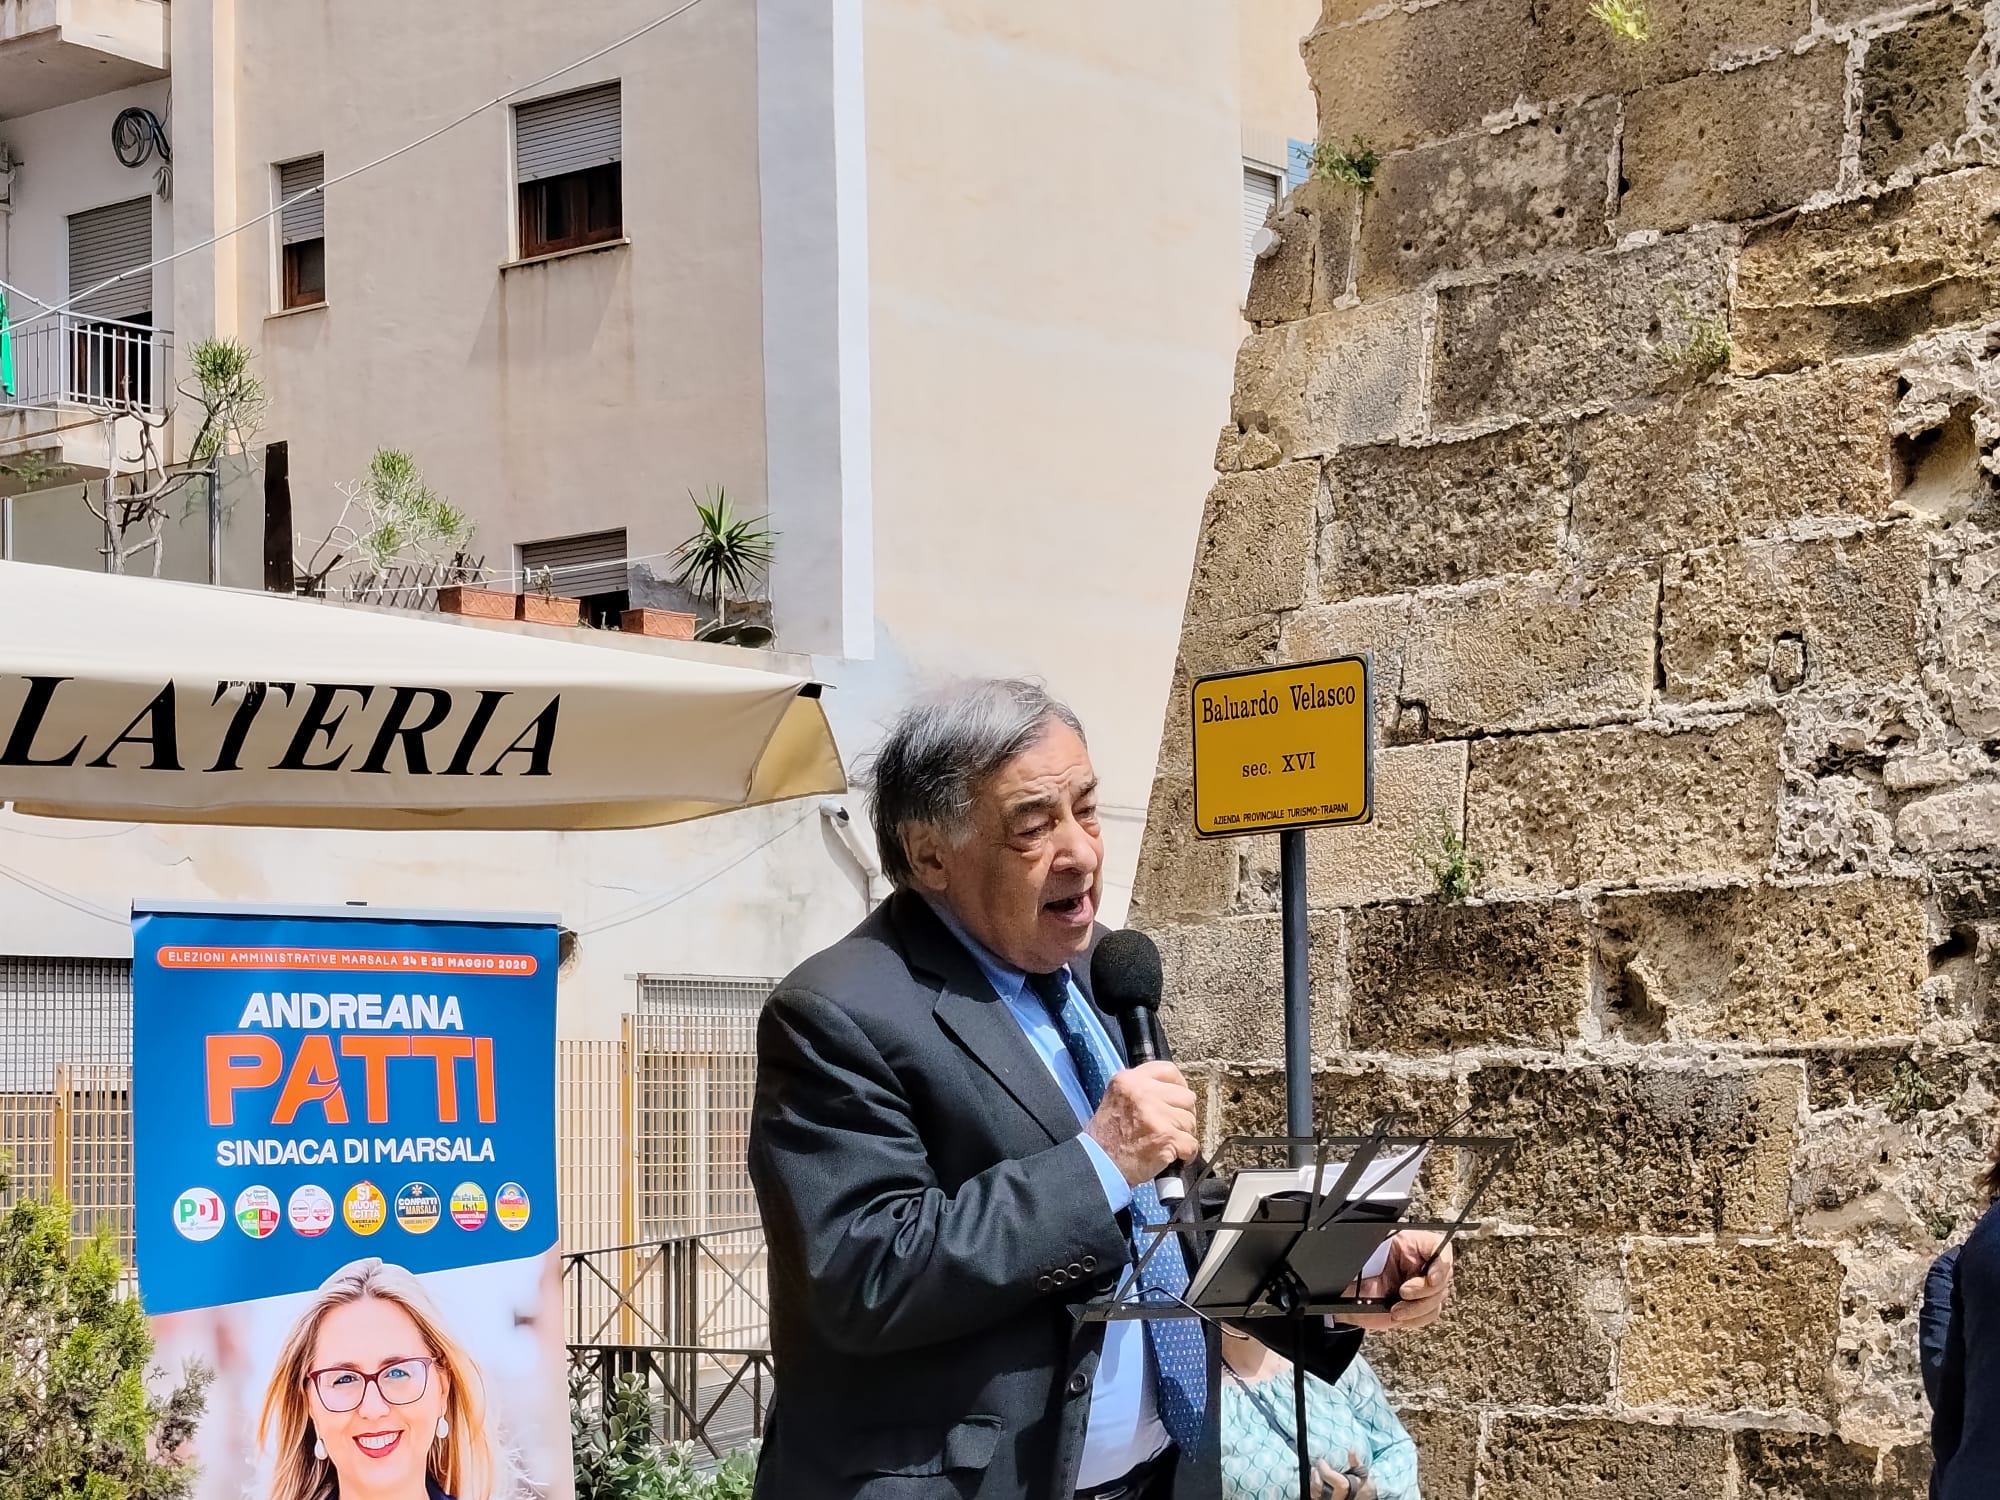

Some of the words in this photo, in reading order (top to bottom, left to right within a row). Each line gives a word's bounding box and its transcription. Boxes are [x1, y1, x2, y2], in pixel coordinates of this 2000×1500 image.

[1202, 690, 1279, 723] Baluardo
[1290, 683, 1356, 711] Velasco
[0, 675, 561, 777] LATERIA
[1242, 763, 1271, 777] sec.
[1281, 752, 1316, 773] XVI
[1213, 814, 1240, 826] AZIENDA
[1243, 809, 1285, 822] PROVINCIALE
[168, 951, 225, 963] ELEZIONI
[230, 952, 337, 965] AMMINISTRATIVE
[341, 954, 398, 966] MARSALA
[402, 956, 417, 966] 24
[421, 956, 428, 967] E
[431, 957, 444, 968] 25
[448, 957, 495, 969] MAGGIO
[498, 960, 528, 970] 2026
[238, 992, 464, 1031] ANDREANA
[205, 1034, 497, 1127] PATTI
[216, 1139, 339, 1167] SINDACA
[343, 1139, 370, 1164] DI
[378, 1136, 496, 1164] MARSALA
